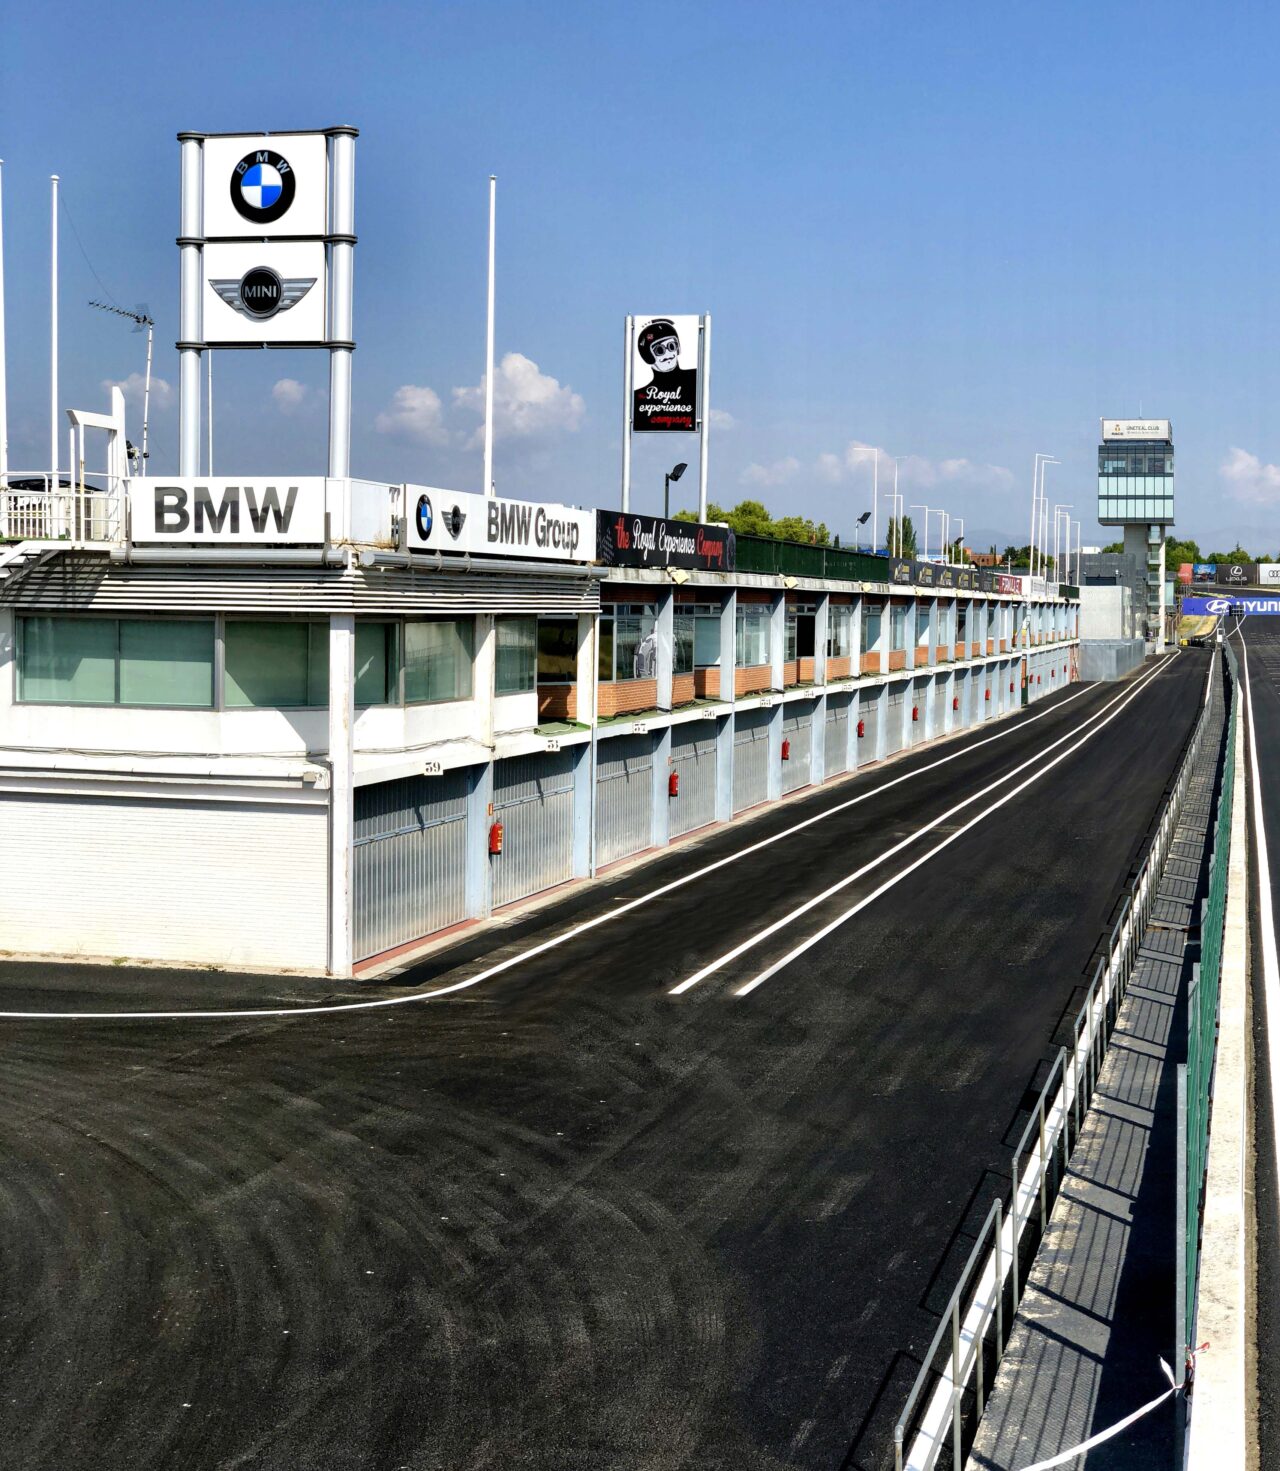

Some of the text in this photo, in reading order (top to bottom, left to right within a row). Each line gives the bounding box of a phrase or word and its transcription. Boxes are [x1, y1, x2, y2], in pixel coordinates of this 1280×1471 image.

[236, 151, 290, 175] BMW
[244, 285, 277, 298] MINI
[646, 386, 682, 404] Royal
[639, 401, 693, 416] experience
[154, 486, 299, 534] BMW
[487, 501, 579, 559] BMW Group
[614, 517, 724, 568] the Royal Experience Company
[425, 761, 441, 773] 39
